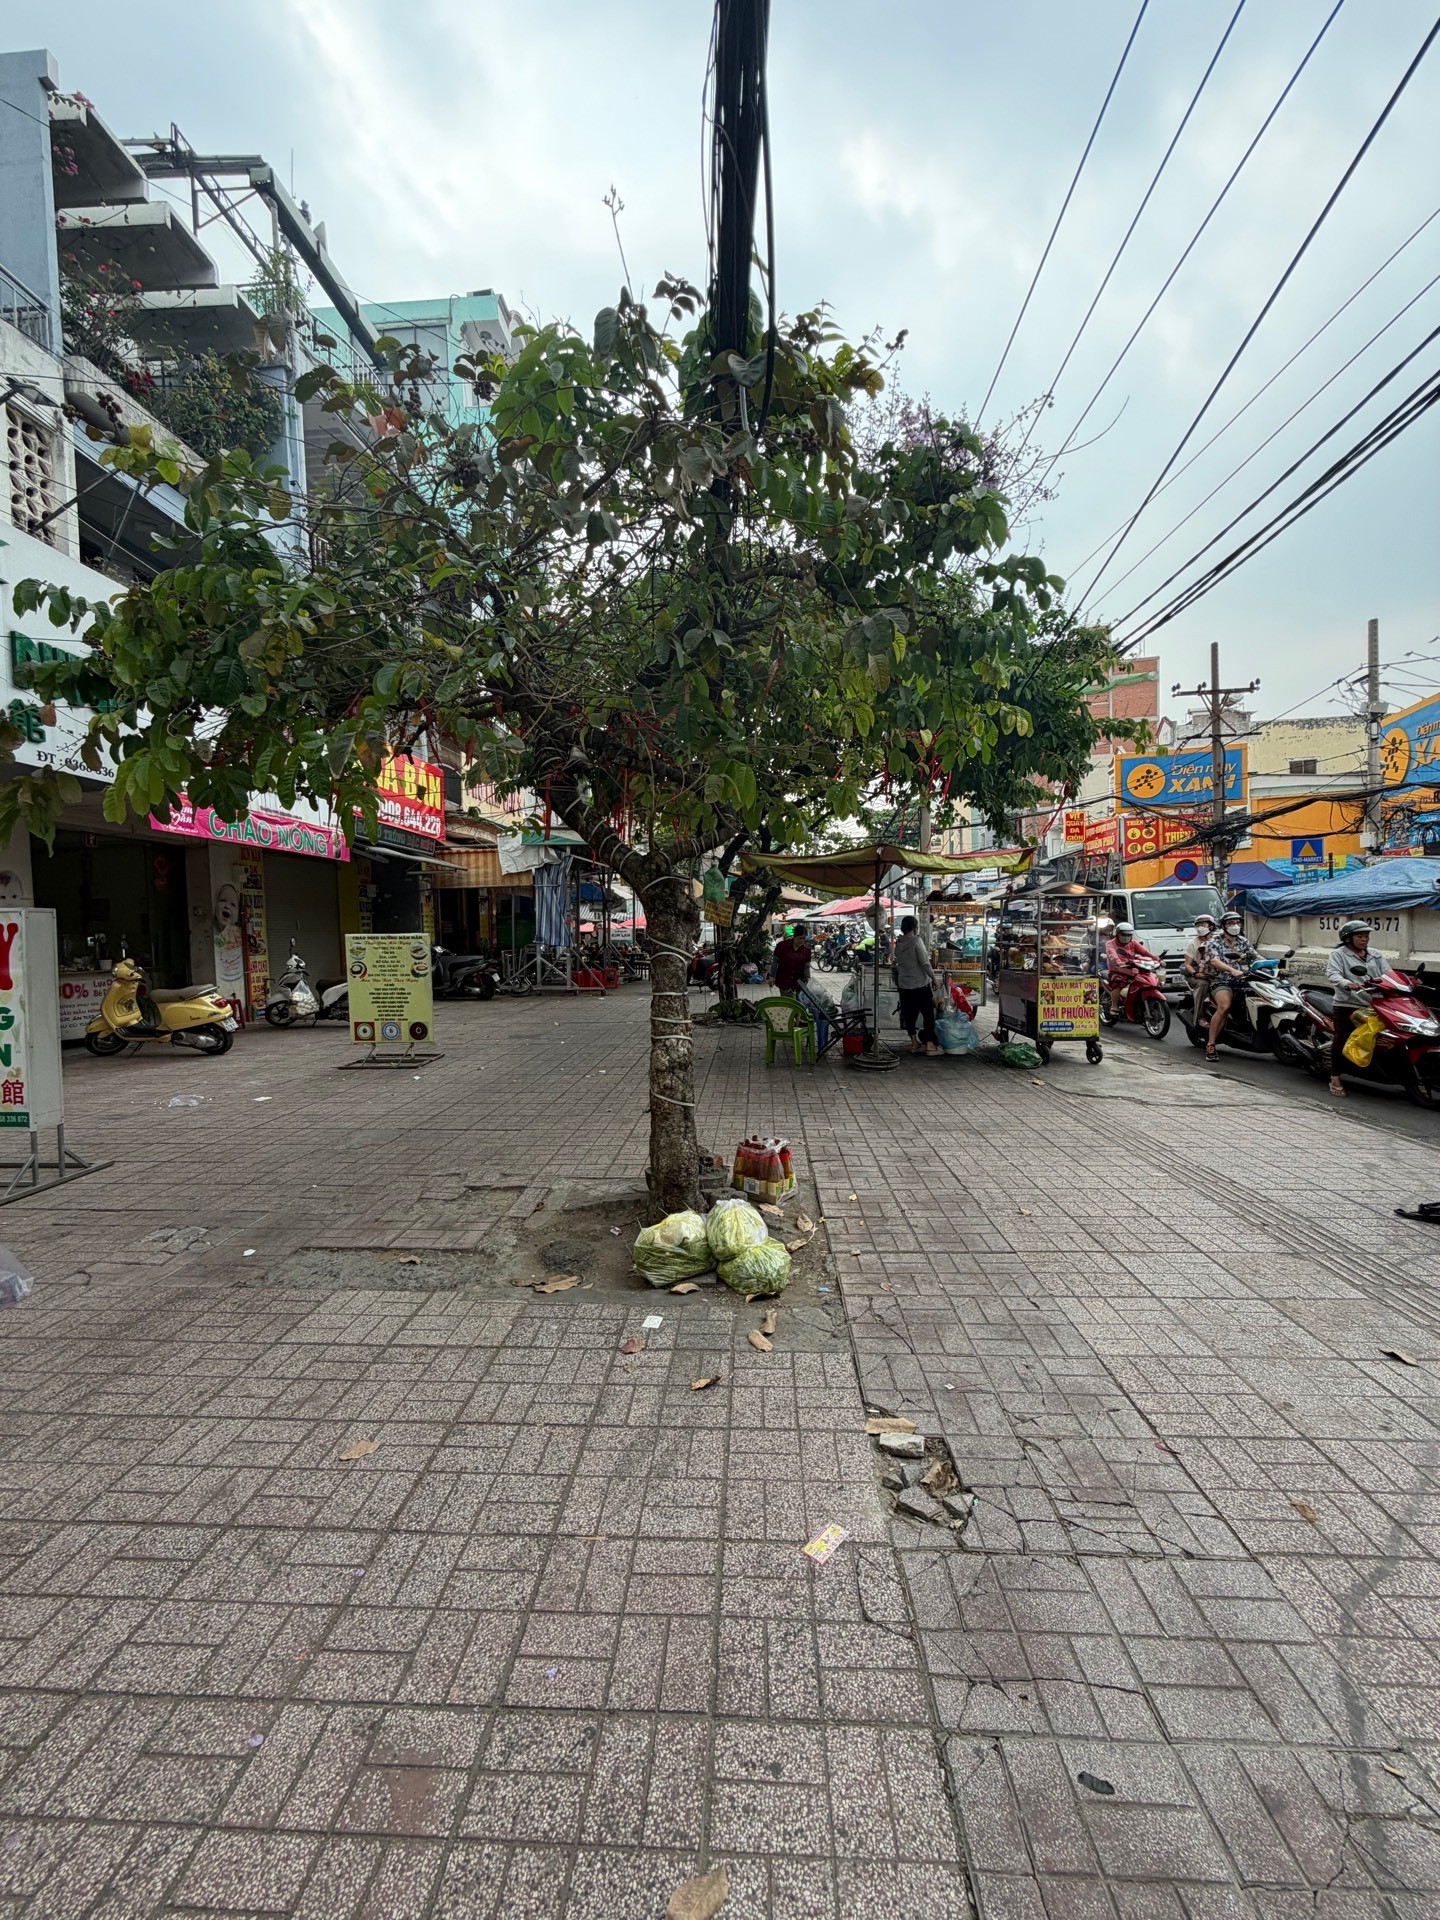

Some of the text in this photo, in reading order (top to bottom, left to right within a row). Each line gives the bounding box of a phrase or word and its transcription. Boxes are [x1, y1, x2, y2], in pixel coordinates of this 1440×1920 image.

[37, 750, 56, 764] ĐT
[1171, 763, 1204, 776] Điện
[404, 761, 441, 810] BÁN
[1320, 917, 1339, 930] 51C
[1042, 1006, 1059, 1019] MAI
[1, 1079, 24, 1105] 館
